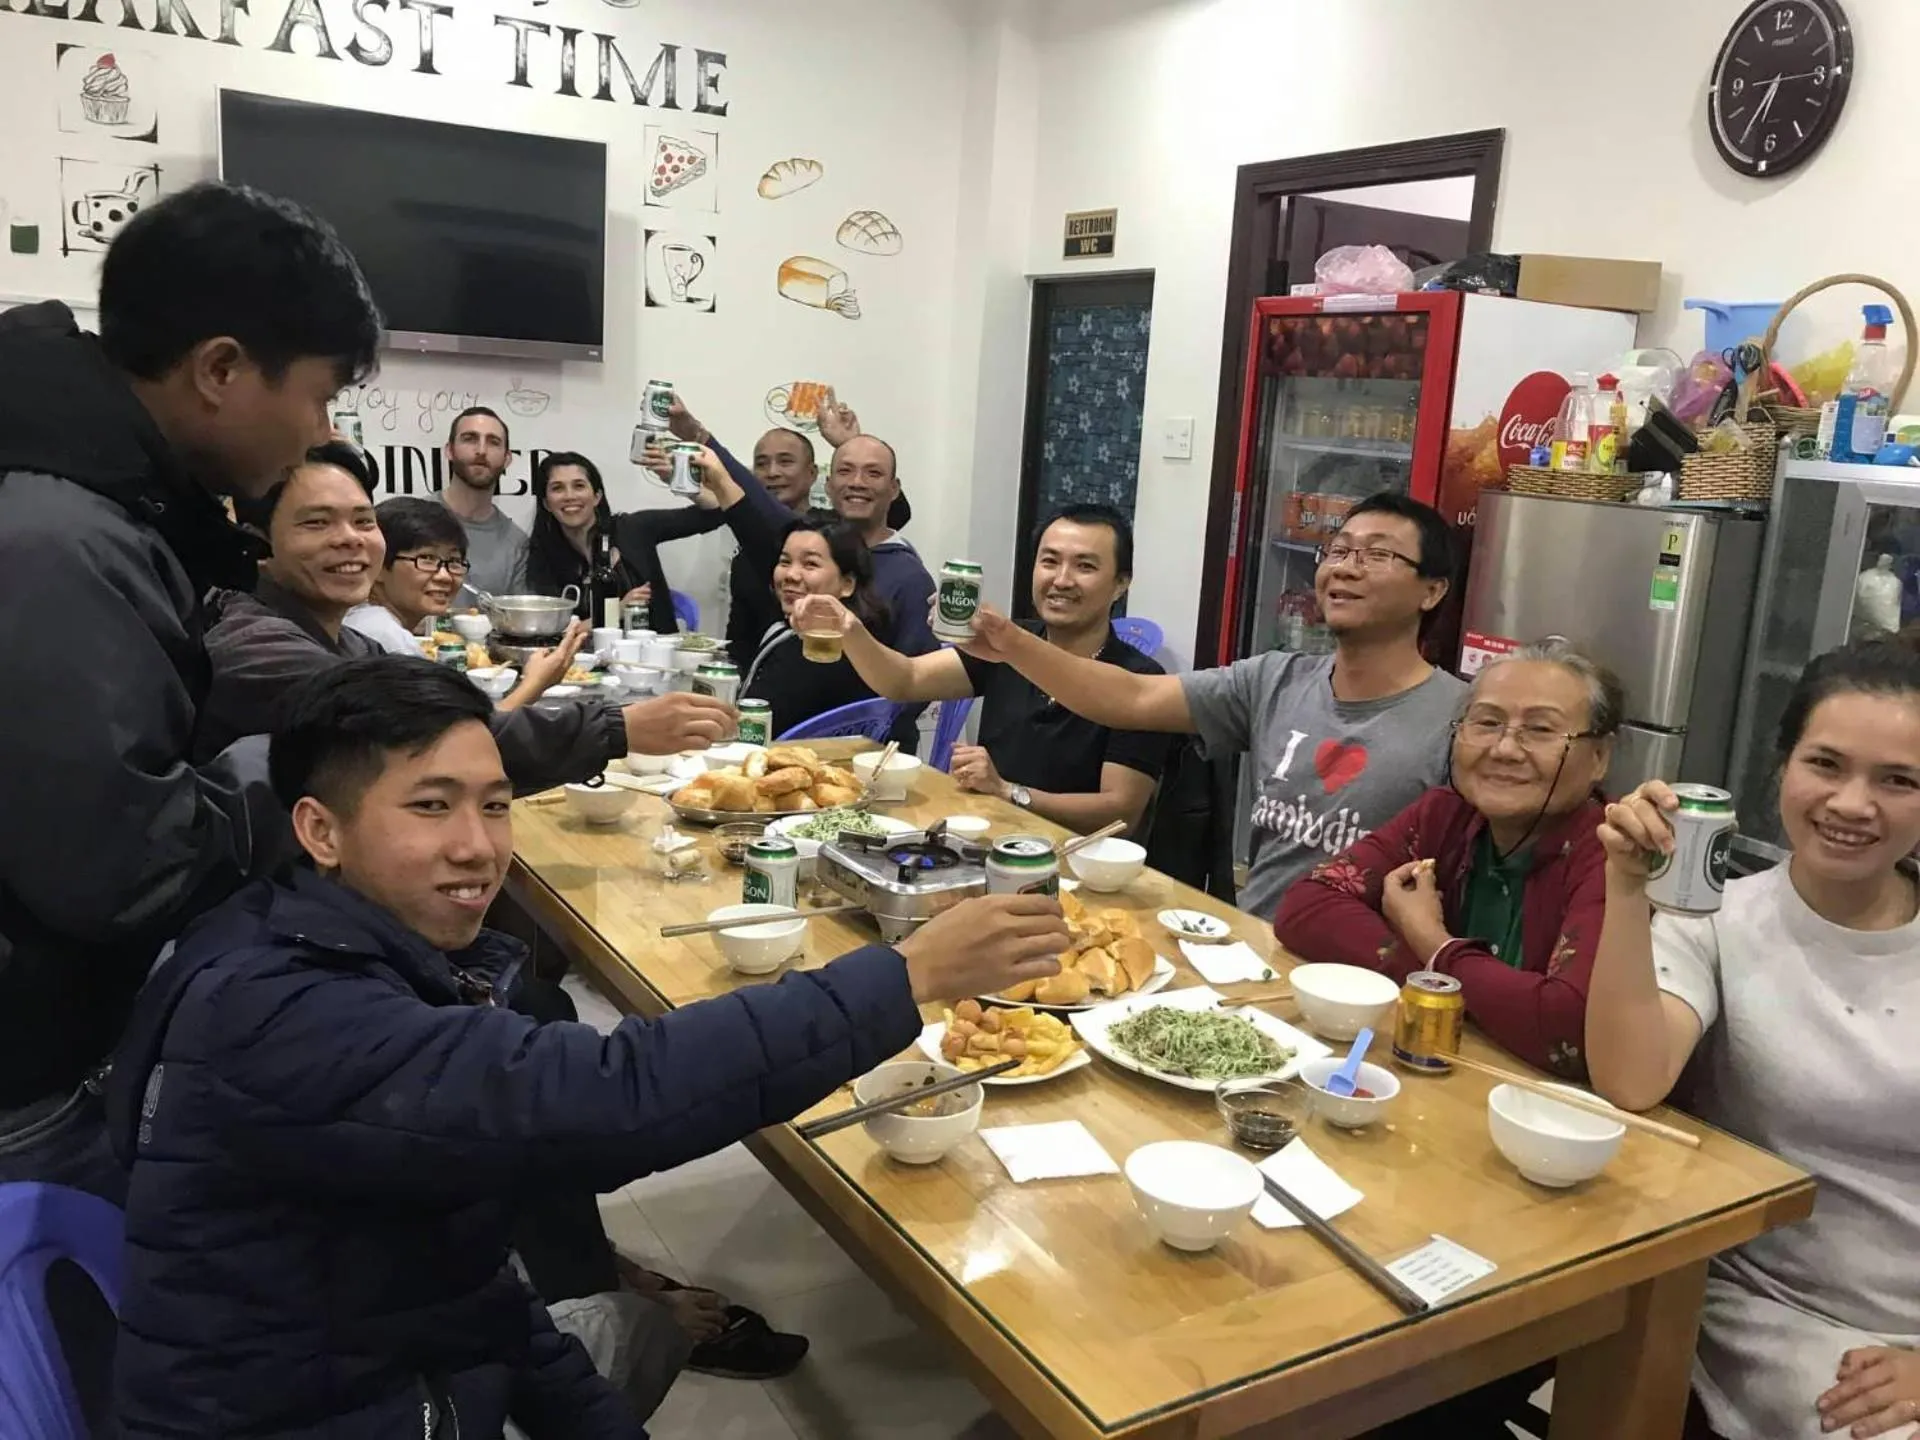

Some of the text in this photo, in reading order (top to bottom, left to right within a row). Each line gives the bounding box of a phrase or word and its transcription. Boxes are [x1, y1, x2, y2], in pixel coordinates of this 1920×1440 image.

[1773, 9, 1794, 31] 12
[493, 14, 729, 117] TIME
[1813, 65, 1826, 85] 3
[1732, 77, 1745, 96] 9
[1764, 133, 1777, 153] 6
[1080, 237, 1099, 254] WC
[336, 384, 479, 433] njoy your
[940, 593, 976, 606] SAIGON
[1271, 729, 1309, 782] I
[1251, 793, 1372, 856] ambodi
